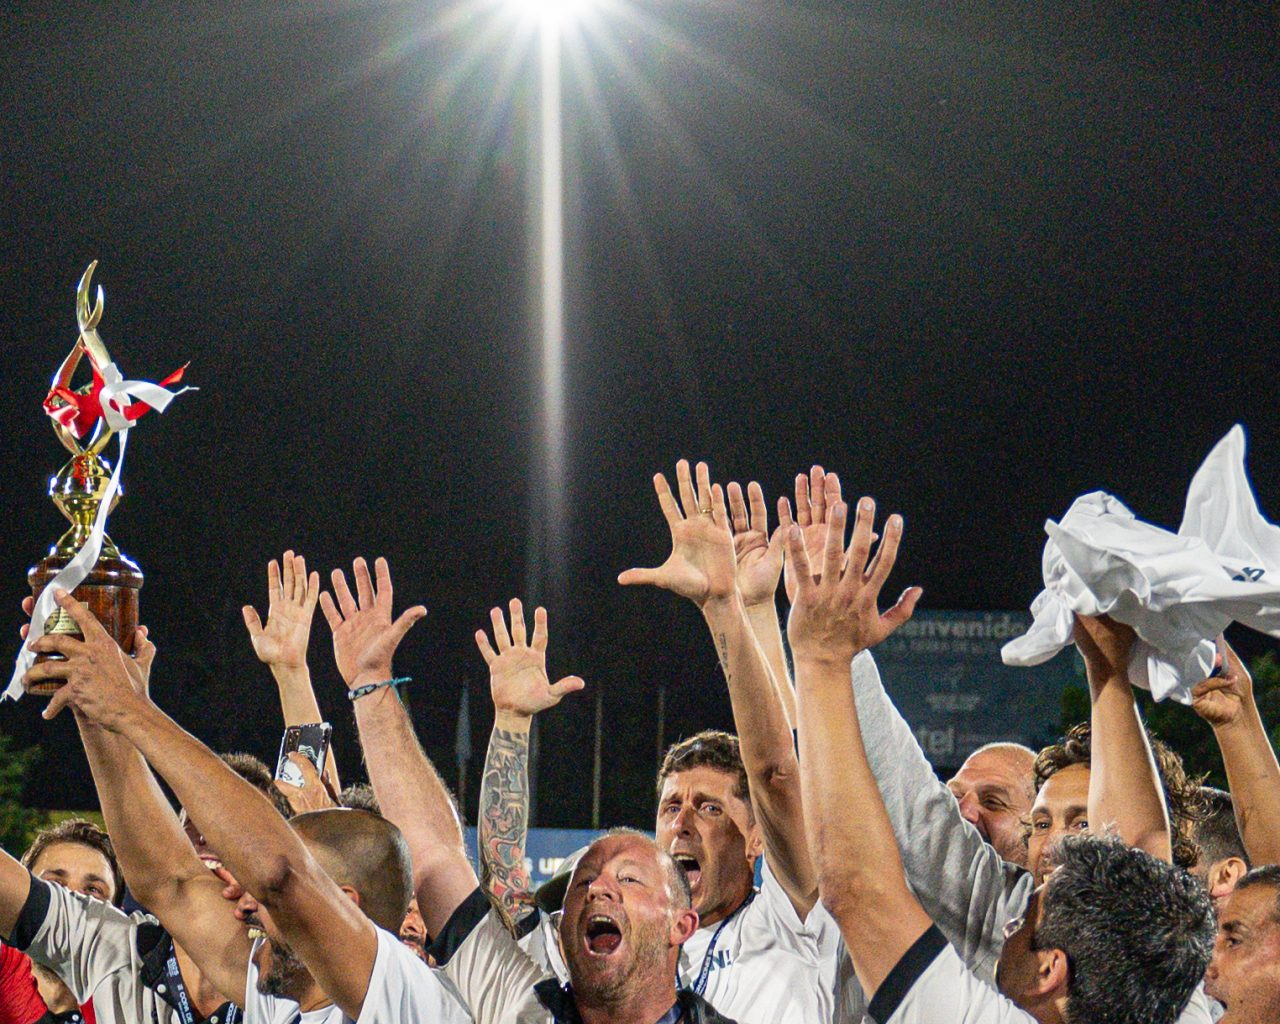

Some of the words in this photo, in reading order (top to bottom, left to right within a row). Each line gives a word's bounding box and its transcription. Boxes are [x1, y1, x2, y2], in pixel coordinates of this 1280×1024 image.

[896, 613, 1026, 638] envenido
[918, 724, 955, 754] tel
[178, 992, 190, 1015] COPA
[186, 1014, 194, 1024] DE
